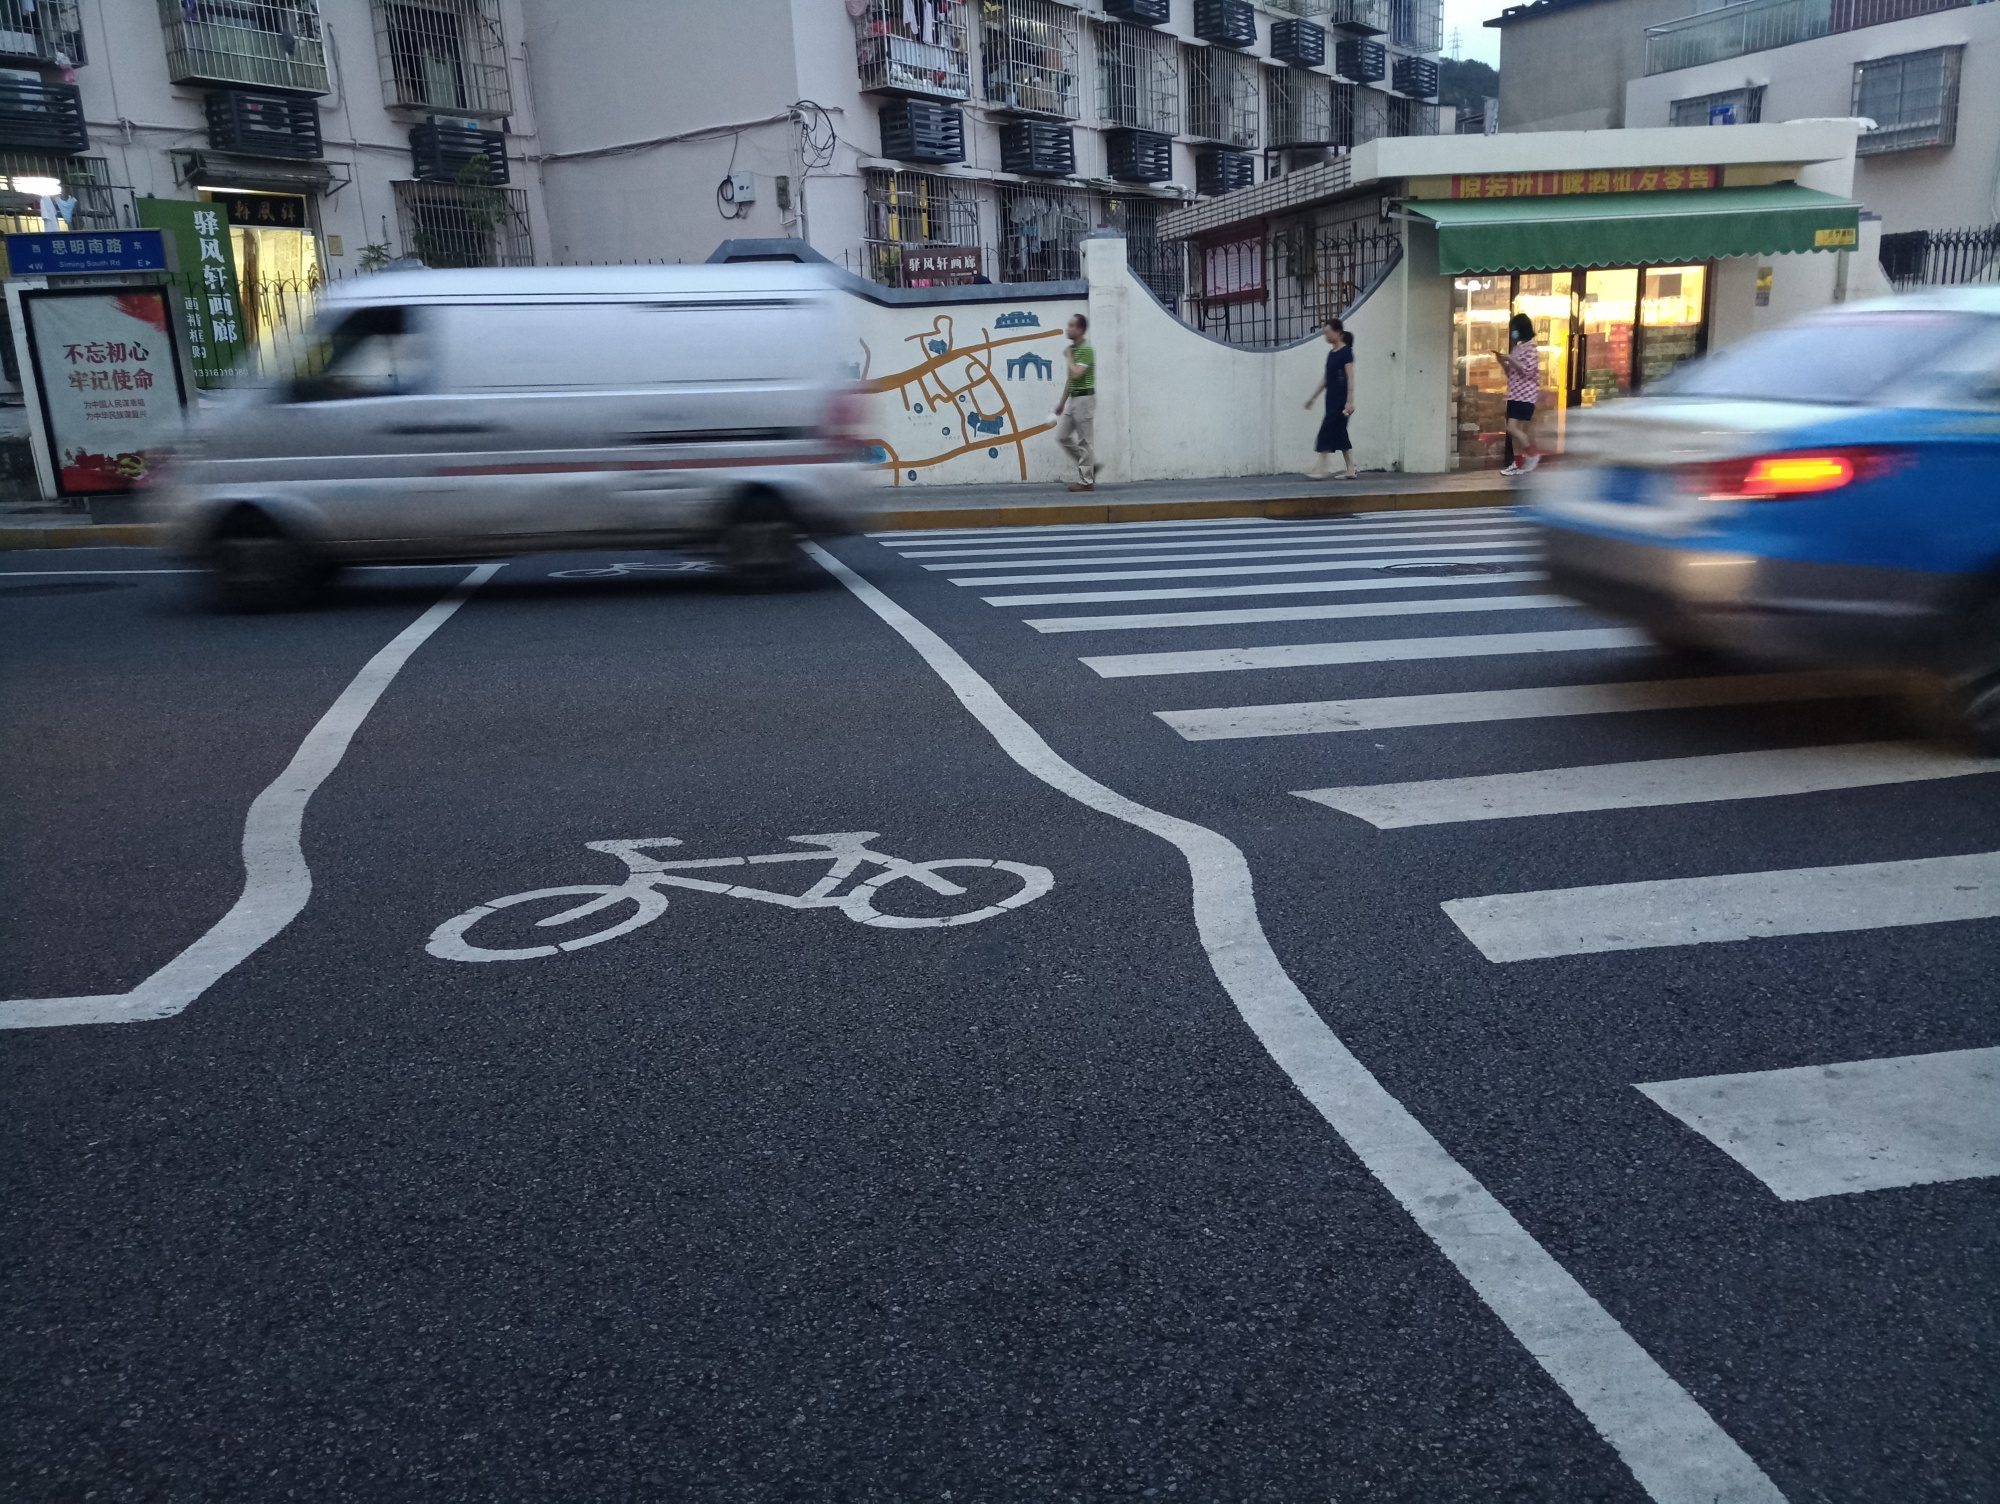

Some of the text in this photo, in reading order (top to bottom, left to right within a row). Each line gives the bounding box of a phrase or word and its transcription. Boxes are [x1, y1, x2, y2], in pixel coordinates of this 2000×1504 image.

[32, 244, 41, 253] 西
[52, 238, 122, 255] 思明南路
[133, 241, 142, 250] 东
[59, 260, 85, 268] Siming
[110, 259, 121, 267] Rd
[909, 255, 976, 272] 驿风轩画廊
[192, 210, 238, 344] 驿风轩画廊
[62, 341, 150, 364] 不忘初心
[68, 368, 154, 392] 牢记使命
